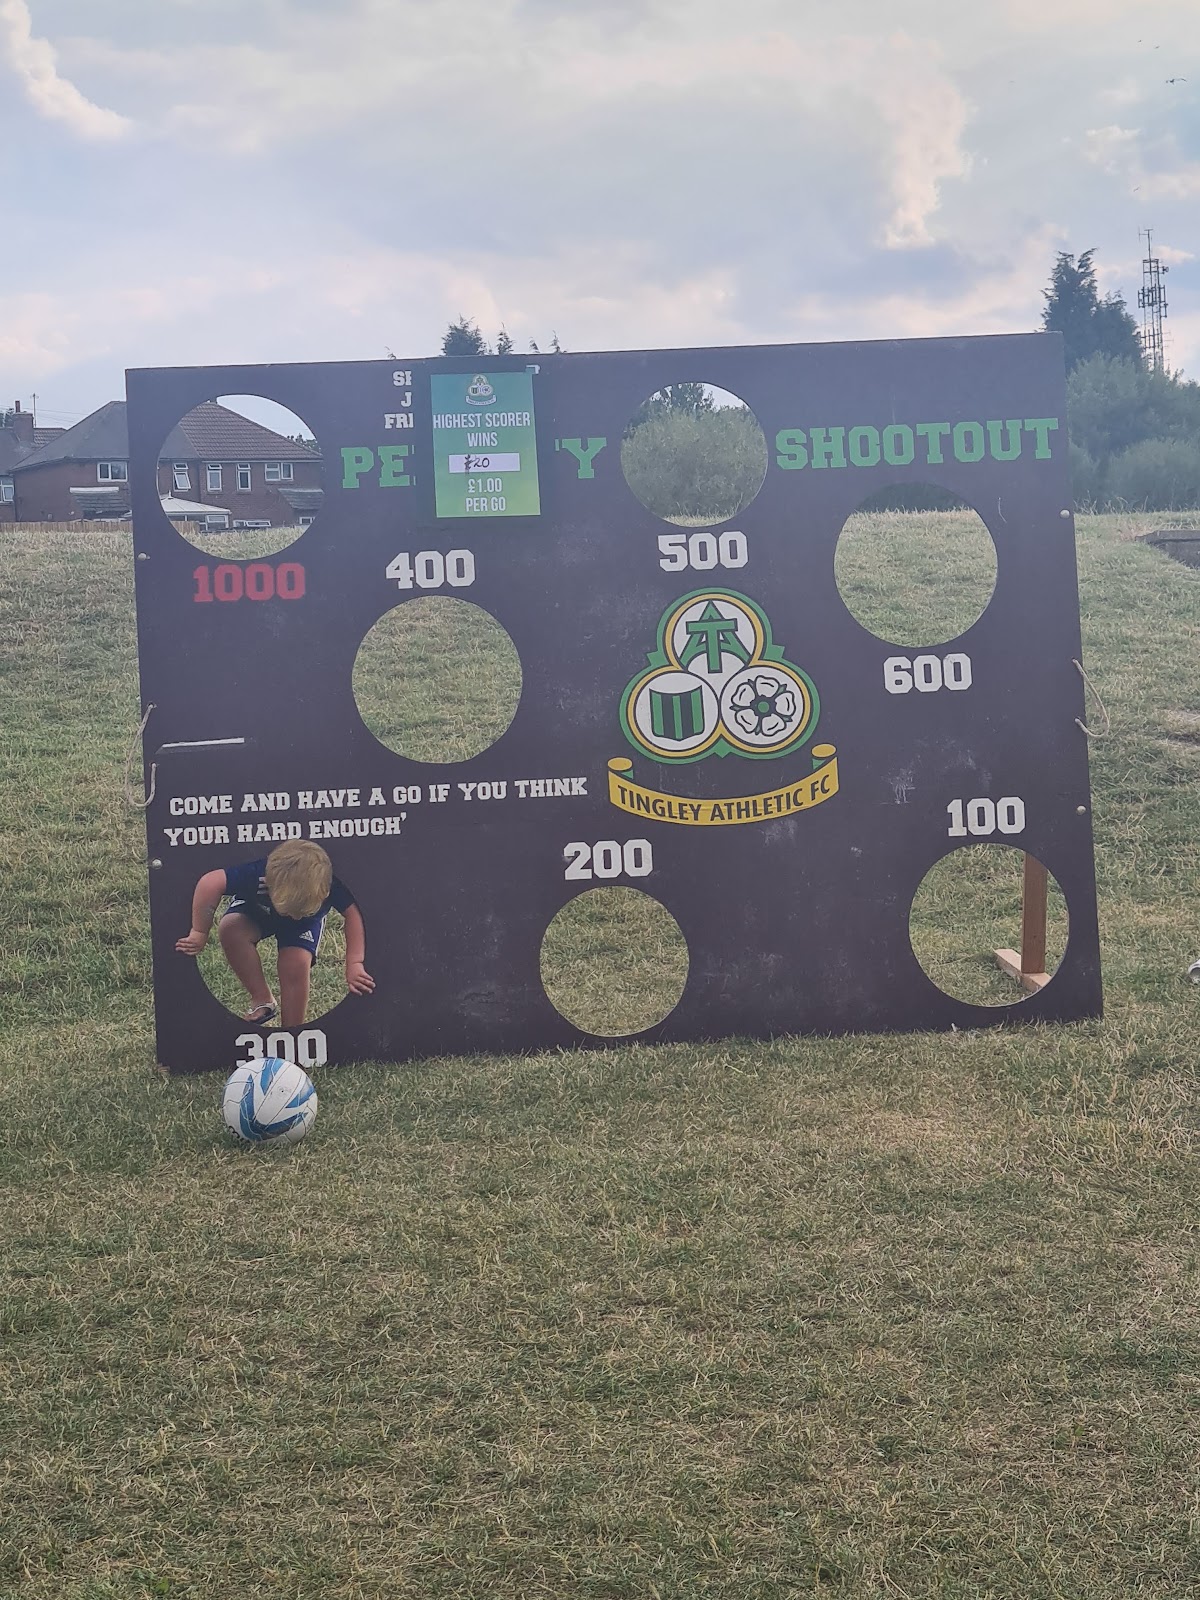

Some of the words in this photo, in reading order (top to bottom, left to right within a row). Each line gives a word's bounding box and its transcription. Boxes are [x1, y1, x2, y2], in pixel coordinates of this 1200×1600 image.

[432, 413, 483, 429] HIGHEST
[485, 412, 531, 428] SCORER
[467, 432, 499, 447] WINS
[340, 445, 416, 488] PE
[775, 418, 1059, 470] SHOOTOUT
[466, 497, 488, 512] PER
[491, 496, 506, 511] GO
[468, 478, 502, 493] £1.00
[385, 549, 476, 589] 400
[658, 531, 749, 572] 500
[193, 562, 306, 602] 1000
[883, 653, 972, 694] 600
[169, 795, 233, 816] COME
[240, 792, 291, 812] AND
[297, 788, 361, 809] HAVE
[368, 787, 387, 806] A
[393, 785, 422, 805] GO
[428, 783, 451, 803] IF
[457, 781, 508, 801] YOU
[514, 777, 588, 798] THINK
[617, 784, 702, 822] TINGLEY
[709, 788, 804, 822] ATHLETIC
[810, 774, 831, 801] FC
[946, 796, 1026, 837] 100
[163, 825, 230, 847] YOUR
[236, 821, 302, 842] HARD
[563, 838, 654, 880] 200
[235, 1029, 328, 1068] 300
